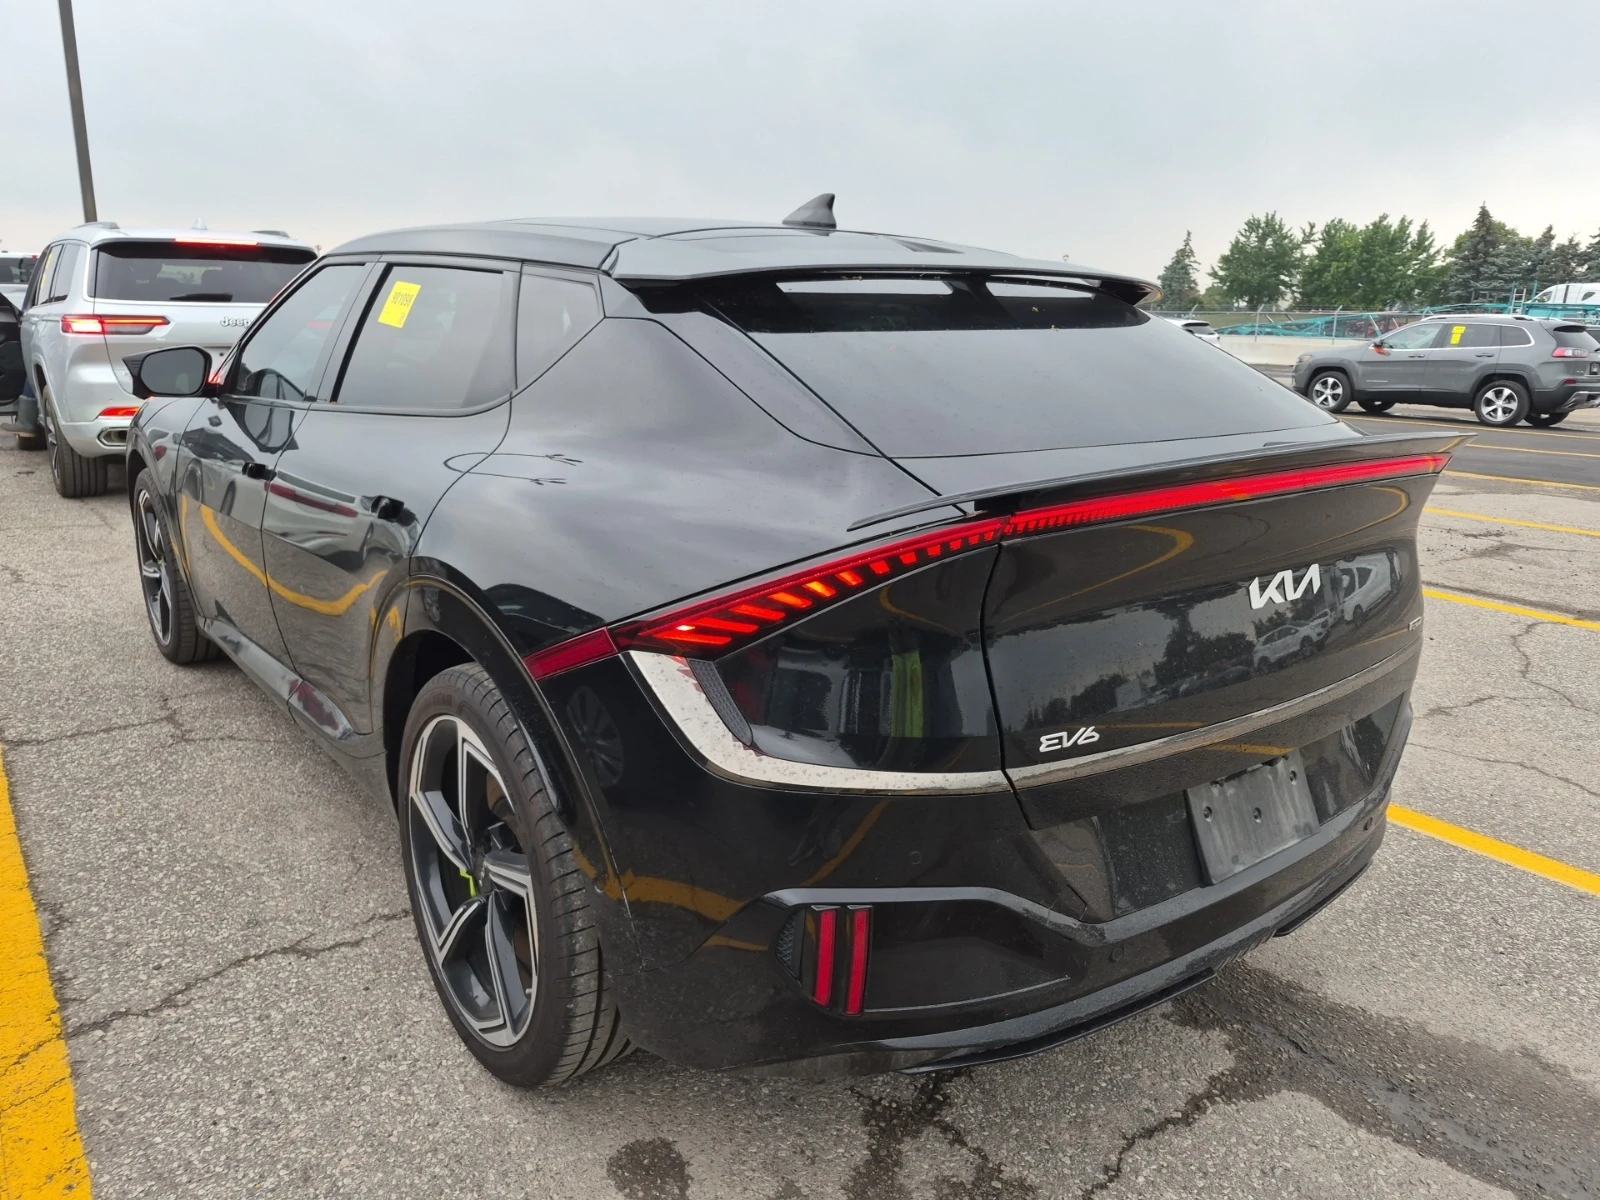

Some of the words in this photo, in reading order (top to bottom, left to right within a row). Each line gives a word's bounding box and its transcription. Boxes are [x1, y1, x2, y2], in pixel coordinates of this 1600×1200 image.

[220, 316, 251, 329] Jeep
[1249, 563, 1321, 610] KIA
[1039, 725, 1100, 753] EV6
